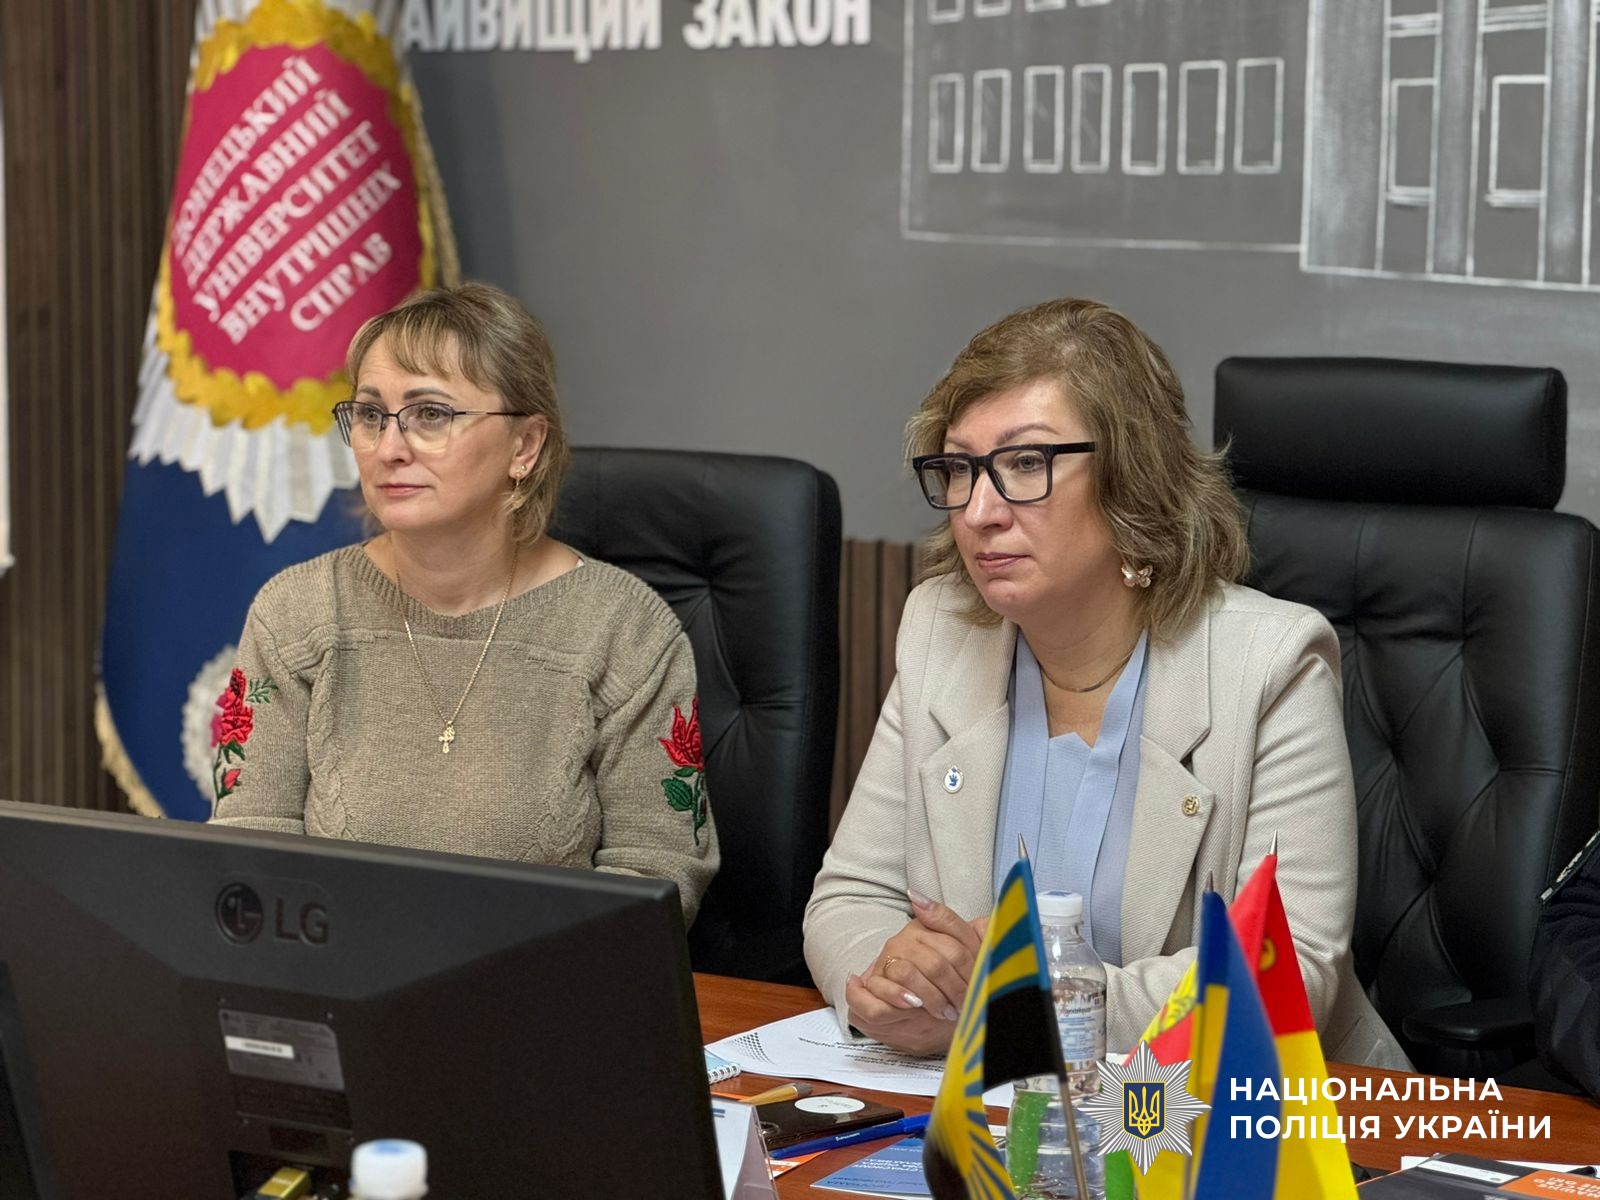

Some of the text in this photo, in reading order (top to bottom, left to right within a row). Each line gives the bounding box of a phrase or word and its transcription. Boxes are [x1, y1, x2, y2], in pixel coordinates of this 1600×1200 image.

[682, 0, 870, 50] ЗАКОН
[171, 55, 321, 259] ДОНЕЦЬКИЙ
[182, 89, 353, 289] ДЕРЖАВНИЙ
[194, 121, 380, 323] УНІВЕРСИТЕТ
[218, 160, 401, 345] ВНУТРІШНІХ
[290, 233, 392, 331] СПРАВ
[275, 897, 330, 945] LG
